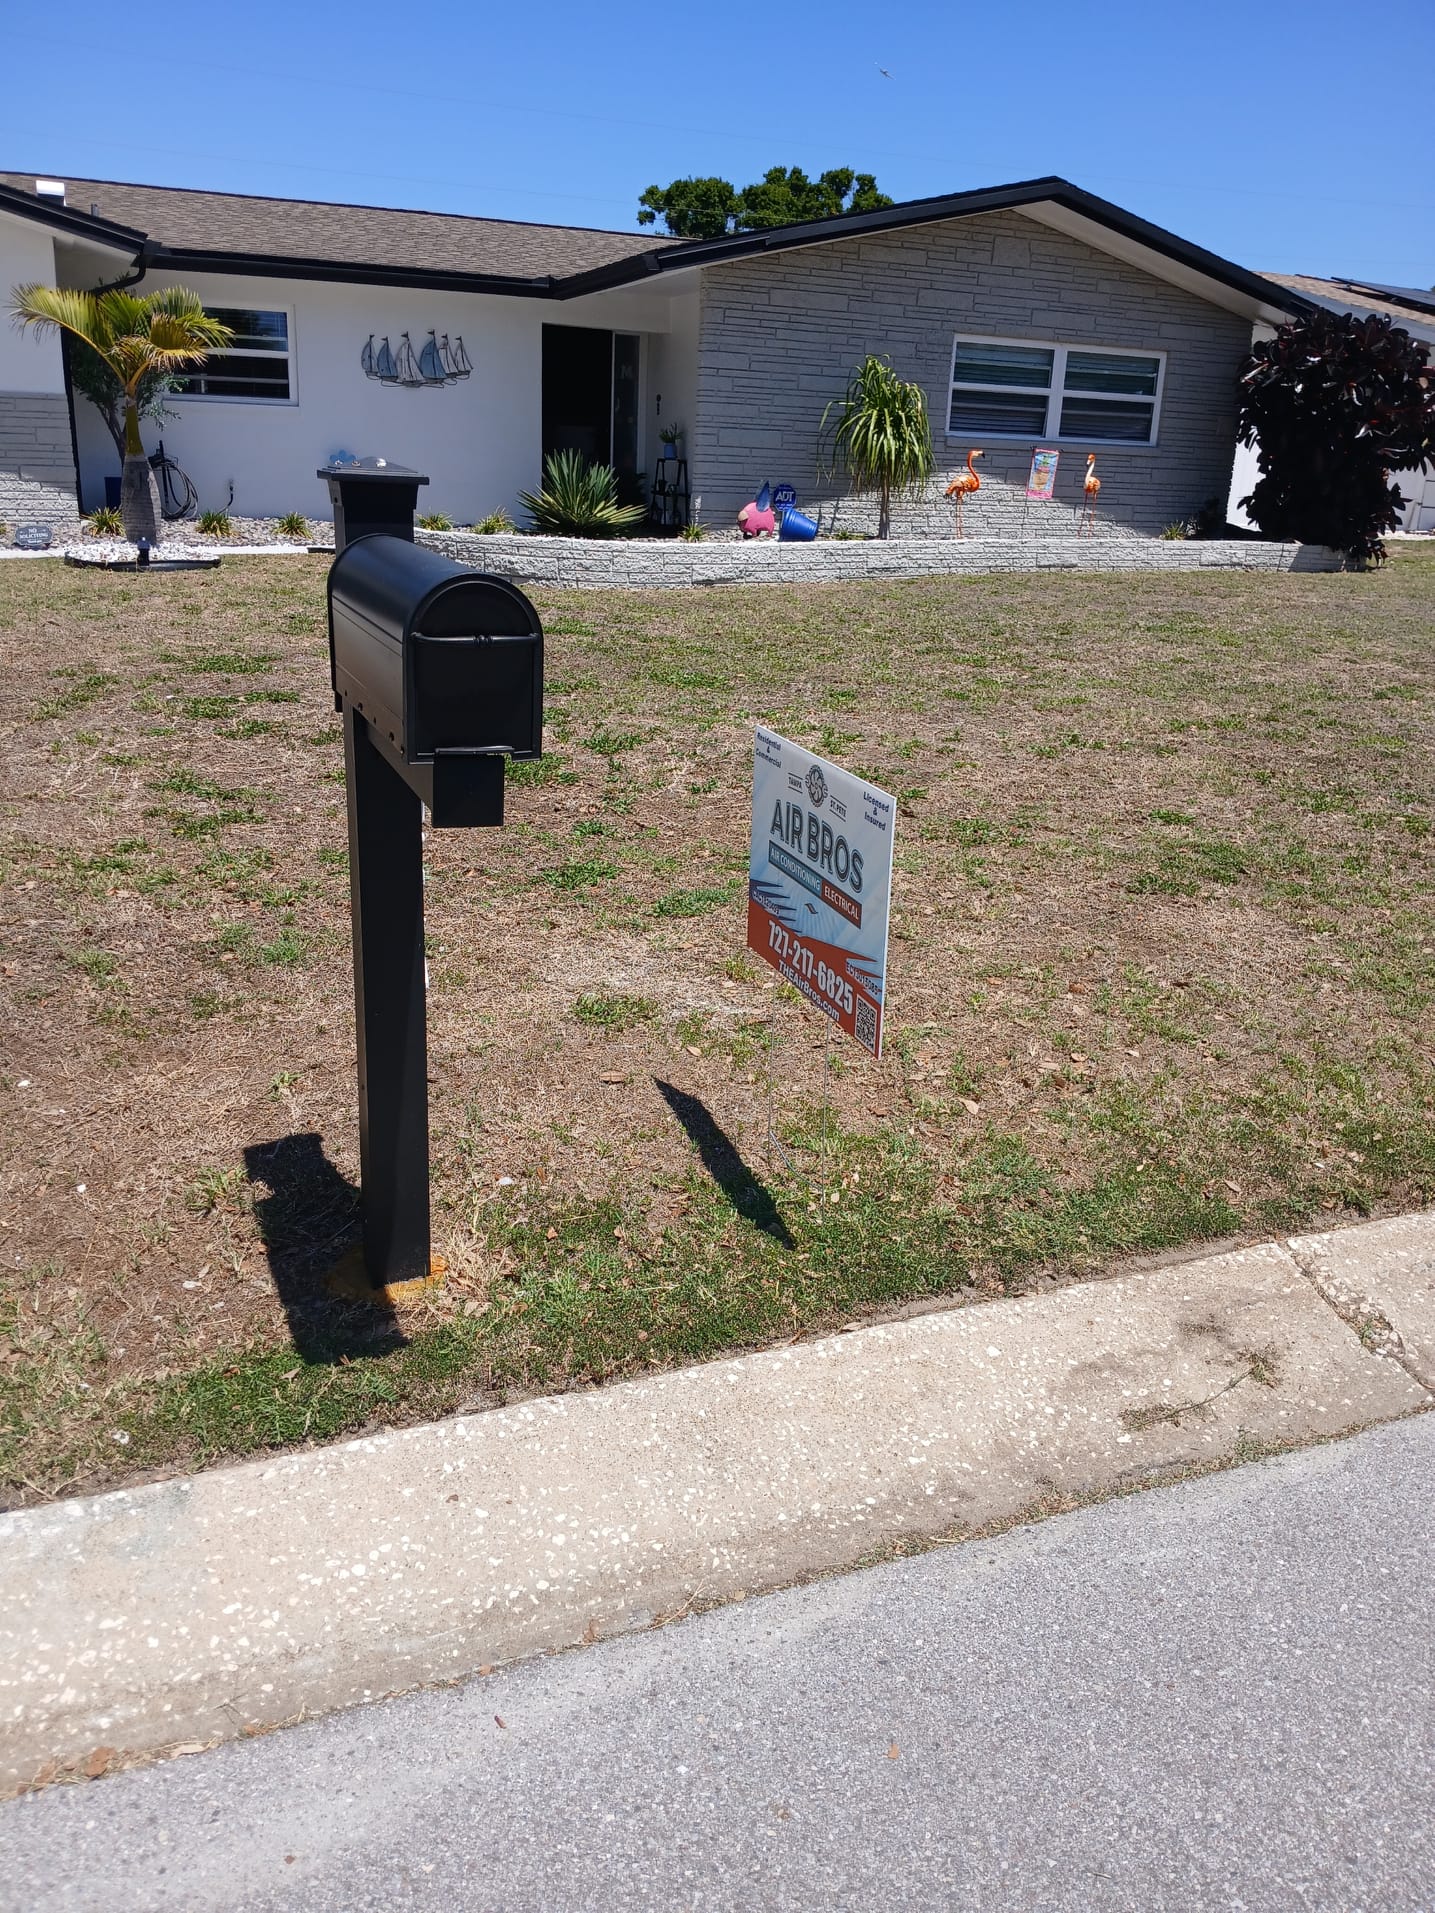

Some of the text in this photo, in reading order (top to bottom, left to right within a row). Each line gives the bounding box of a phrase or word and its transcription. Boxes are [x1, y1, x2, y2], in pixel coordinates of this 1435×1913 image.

[775, 491, 795, 502] ADT
[756, 732, 782, 751] Residential
[755, 748, 782, 768] Commercial
[788, 776, 803, 790] TAMPA
[863, 791, 890, 813] Licensed
[872, 808, 878, 816] &
[864, 811, 887, 831] Insured
[770, 848, 821, 890] AIR CONDITIONING
[823, 885, 860, 920] ELECTRICAL
[768, 920, 854, 1015] 727-217-6825
[778, 959, 841, 1021] THEAirBros.com
